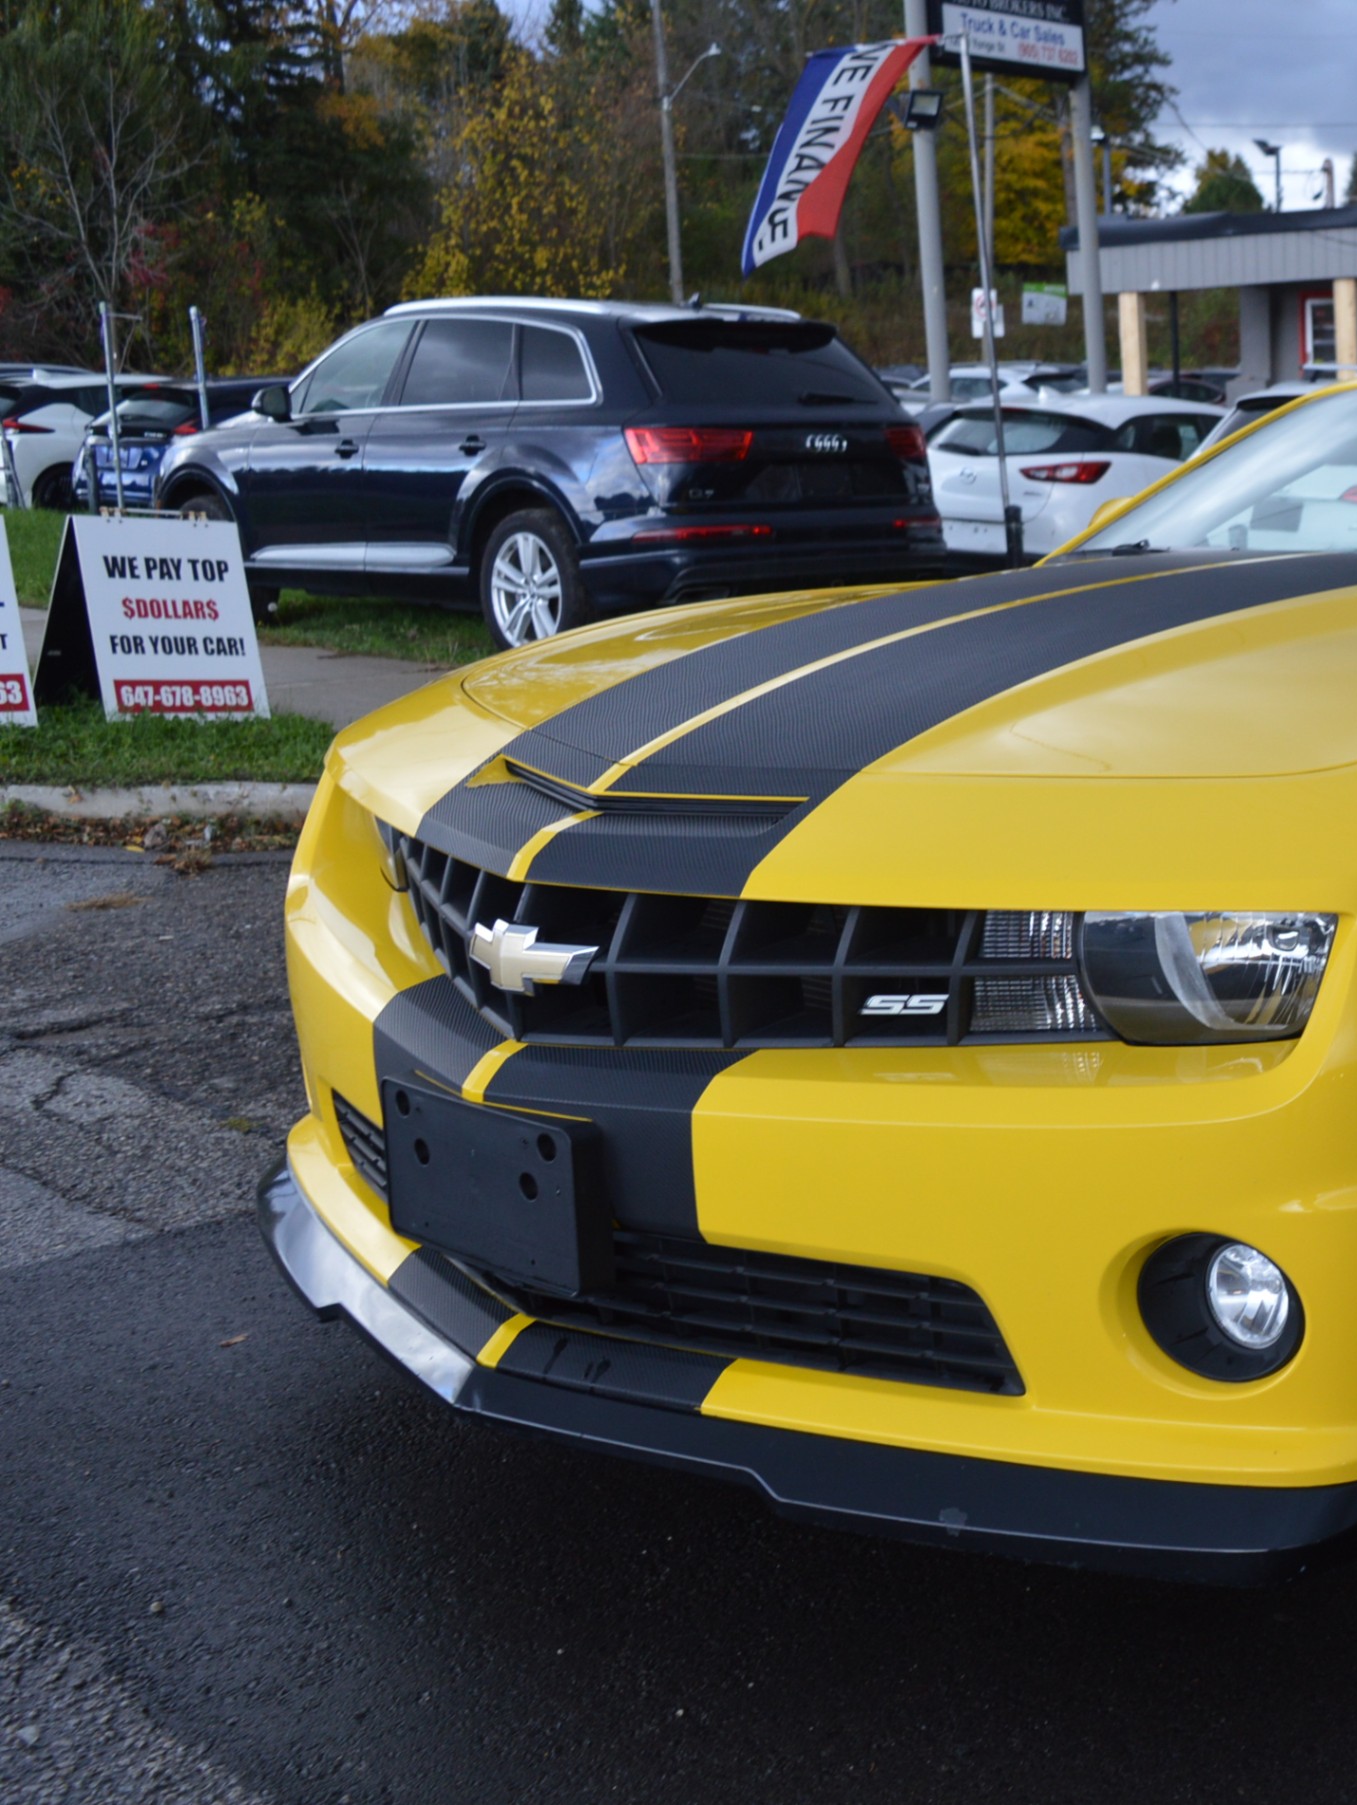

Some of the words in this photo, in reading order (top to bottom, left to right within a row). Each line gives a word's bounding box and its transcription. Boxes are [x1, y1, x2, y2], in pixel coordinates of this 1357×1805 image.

[960, 12, 994, 34] Truck
[1010, 21, 1030, 41] Car
[1034, 24, 1065, 45] Sales
[103, 555, 140, 579] WE
[144, 557, 182, 580] PAY
[188, 559, 229, 582] TOP
[122, 597, 219, 622] $DOLLAR$
[110, 634, 145, 655] FOR
[149, 636, 198, 656] YOUR
[203, 637, 246, 656] CAR!
[121, 685, 248, 707] 647-678-8963
[859, 994, 950, 1015] SS
